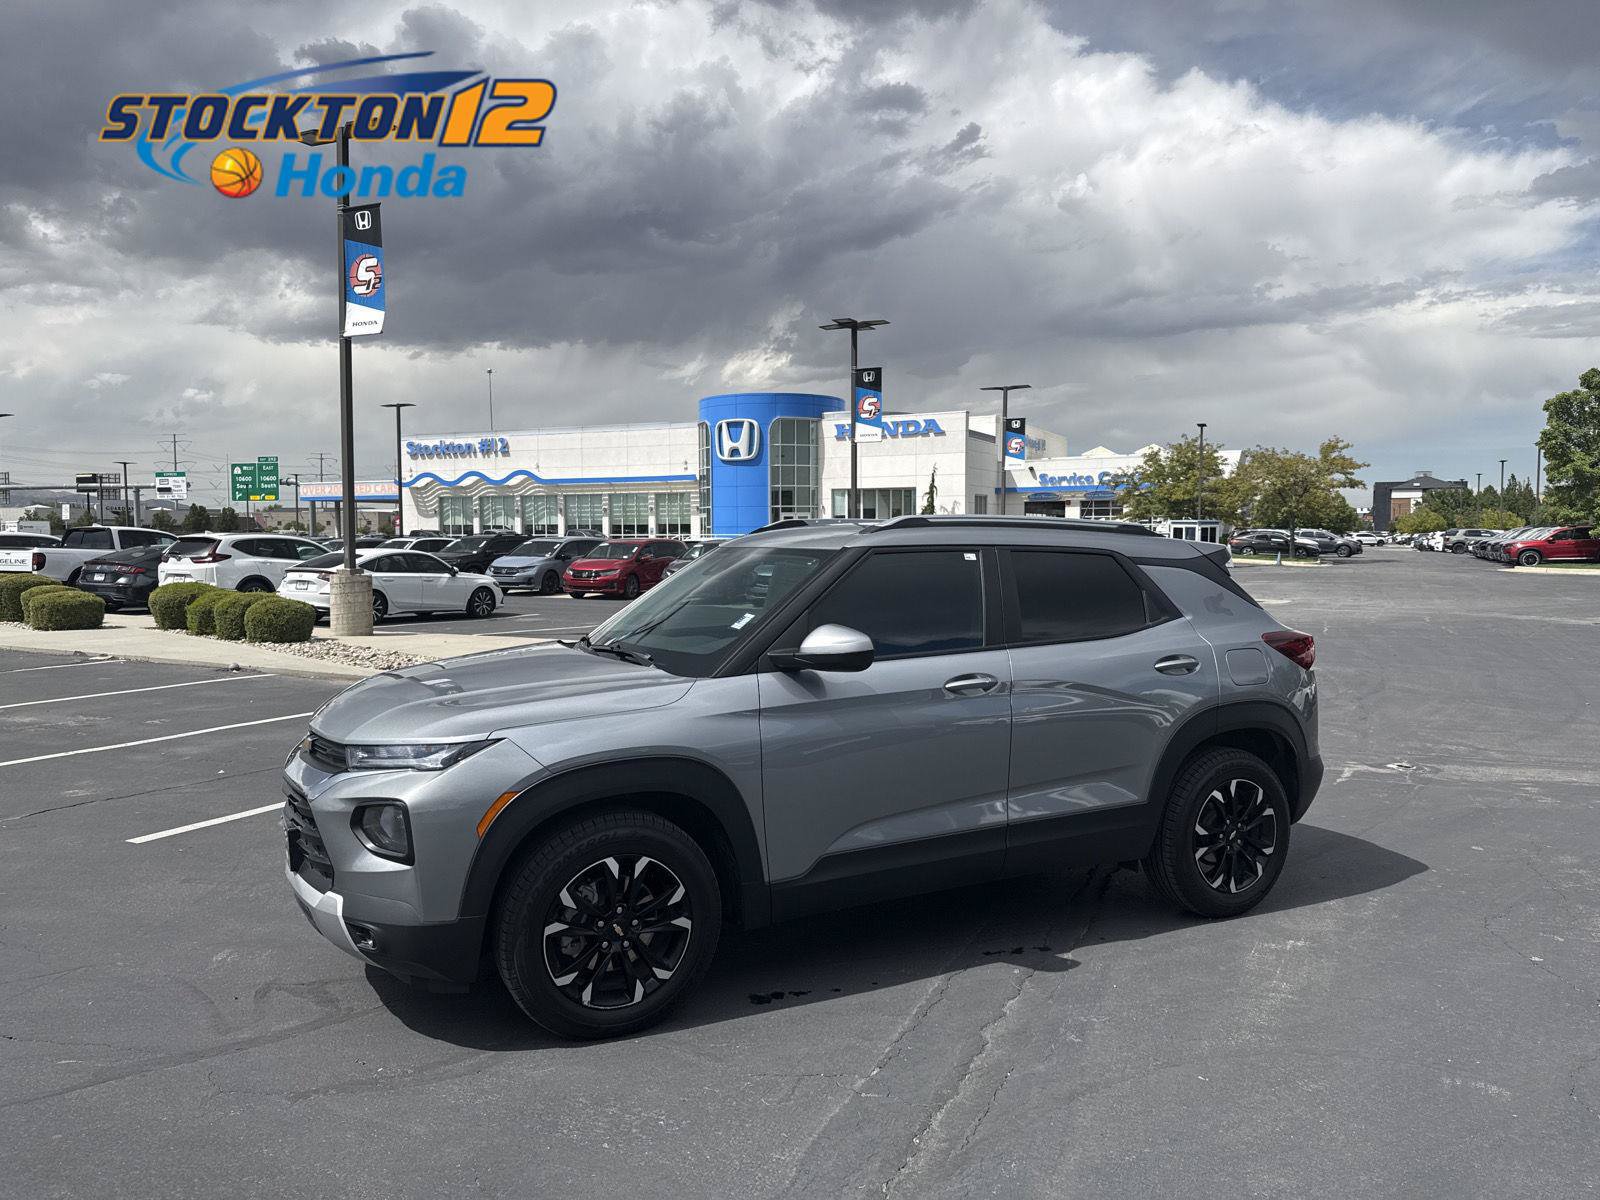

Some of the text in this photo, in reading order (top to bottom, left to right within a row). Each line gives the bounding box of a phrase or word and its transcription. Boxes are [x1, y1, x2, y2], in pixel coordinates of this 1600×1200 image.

[834, 419, 945, 440] HNDA
[406, 440, 474, 456] Stockton
[1038, 471, 1095, 486] Service
[302, 485, 326, 496] OVER
